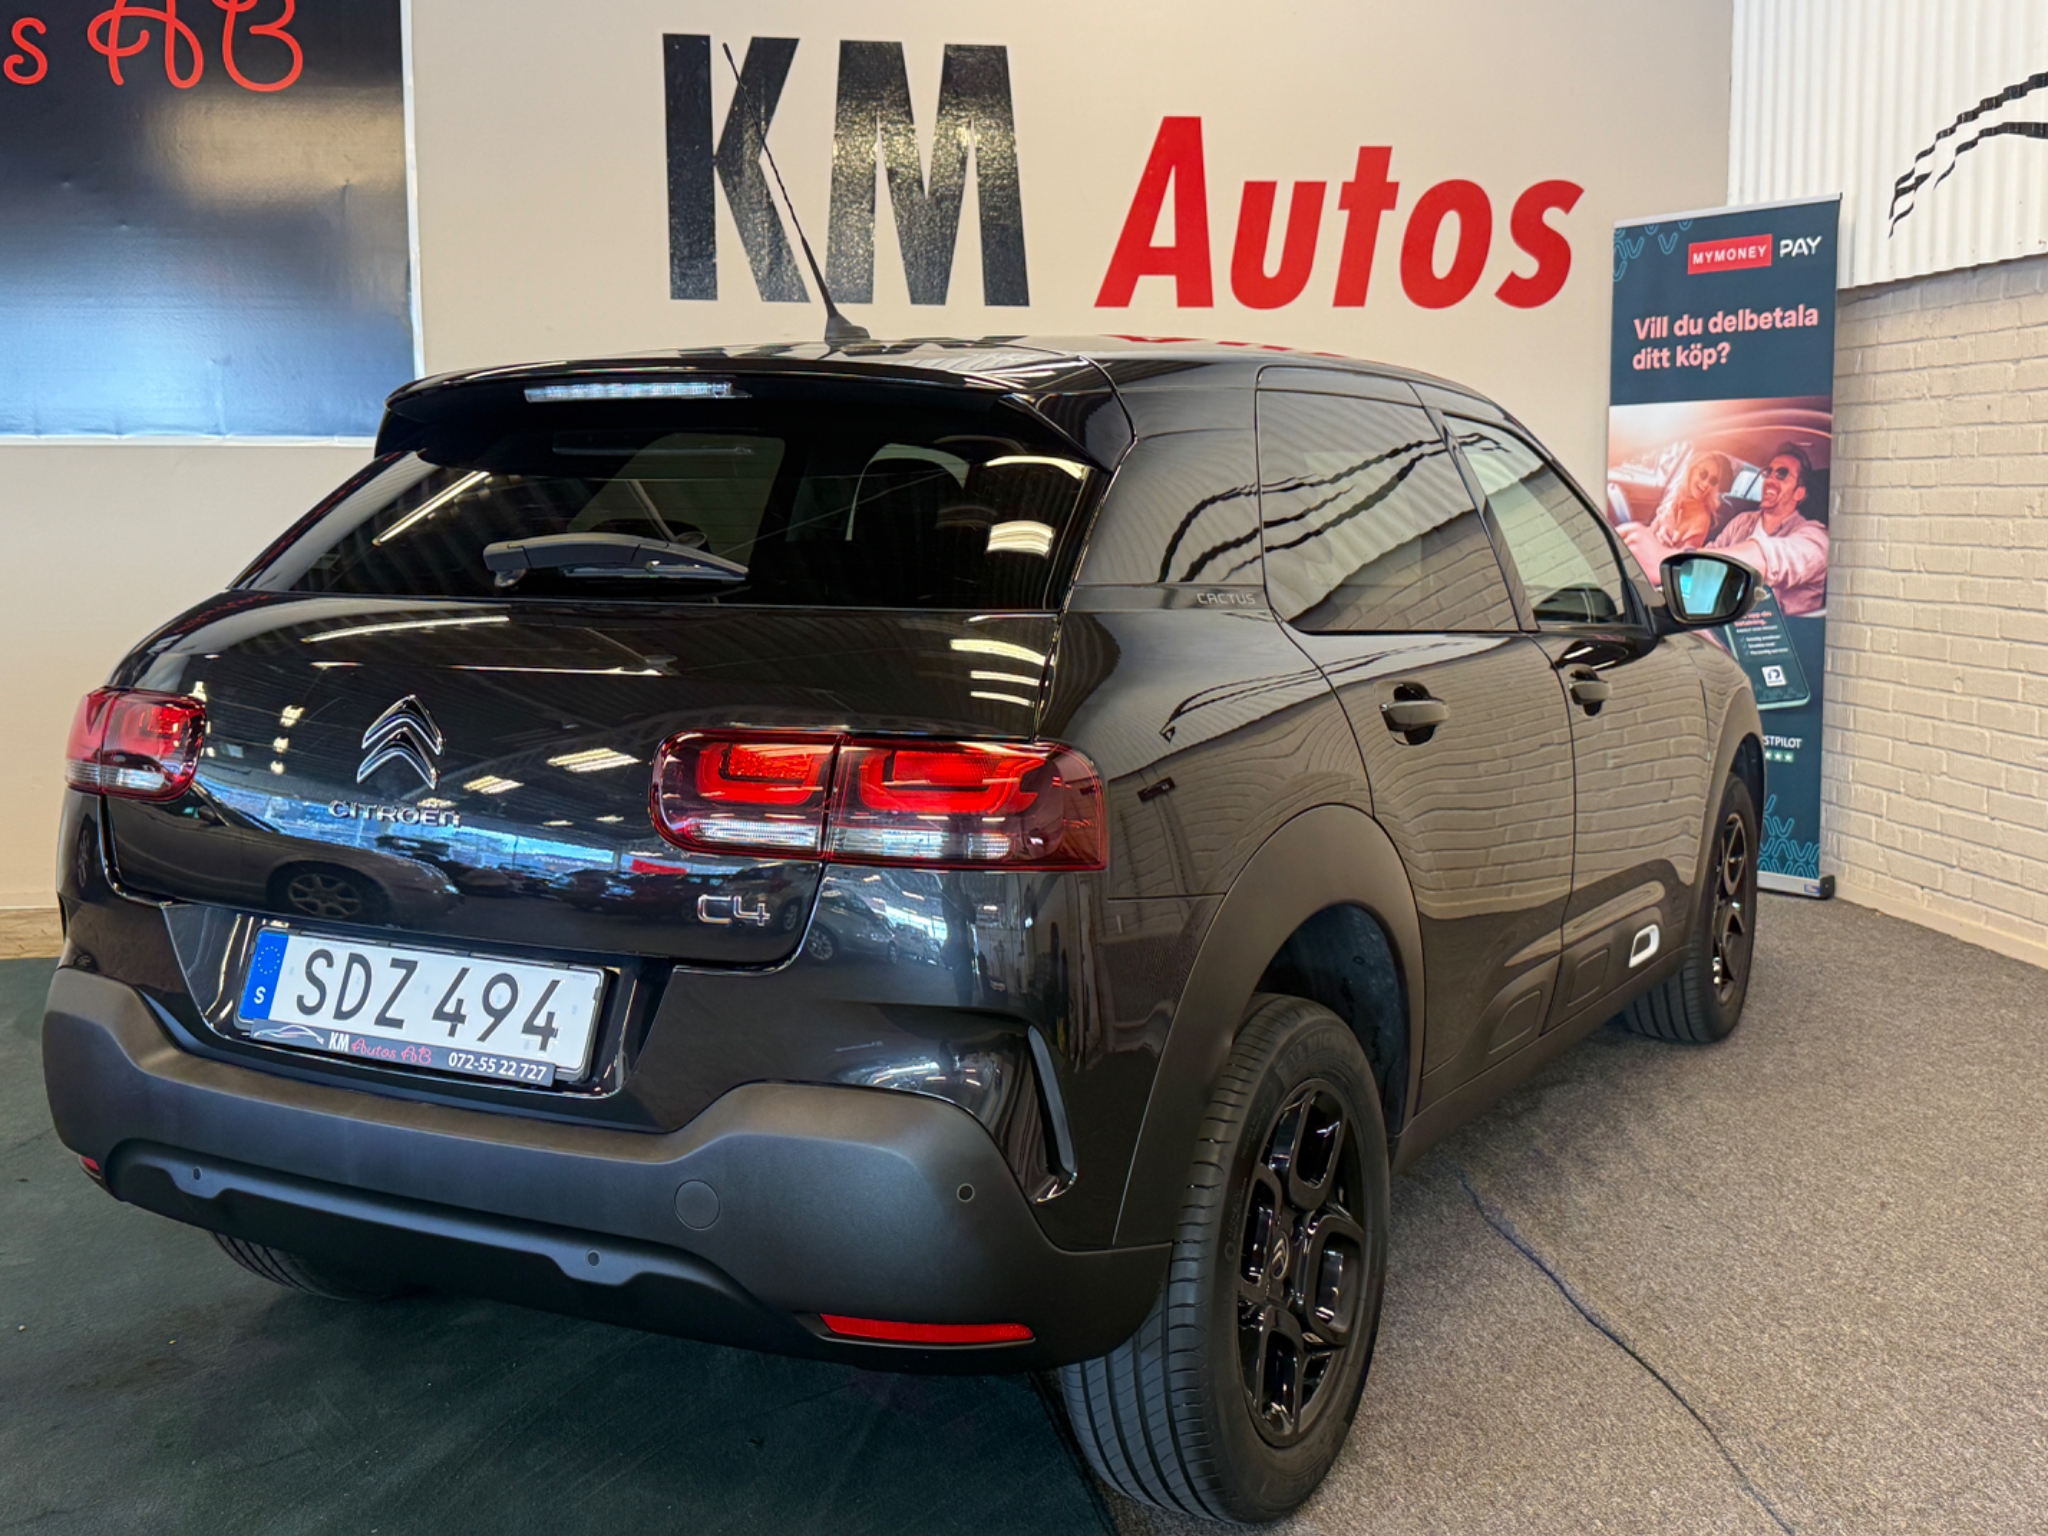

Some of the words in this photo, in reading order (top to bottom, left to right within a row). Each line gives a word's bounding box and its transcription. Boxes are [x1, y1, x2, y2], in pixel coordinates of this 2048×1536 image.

[661, 33, 1030, 307] KM
[1094, 116, 1586, 310] Autos
[1692, 245, 1768, 265] MYMONEY
[1780, 236, 1822, 258] PAY
[1633, 316, 1669, 340] Vill
[1673, 314, 1703, 337] du
[1708, 304, 1819, 334] delbetala
[1632, 347, 1671, 370] ditt
[1675, 342, 1731, 371] köp?
[1196, 592, 1256, 605] CACTUS
[1763, 735, 1802, 749] STPILOT
[698, 894, 771, 926] C4
[253, 988, 267, 1004] S
[296, 949, 418, 1030] SDZ
[432, 967, 563, 1053] 494
[328, 1031, 350, 1052] KM
[351, 1038, 397, 1059] Autos
[401, 1045, 433, 1065] AB
[448, 1051, 497, 1073] 072-55
[498, 1060, 517, 1076] 22
[519, 1063, 548, 1081] 727
